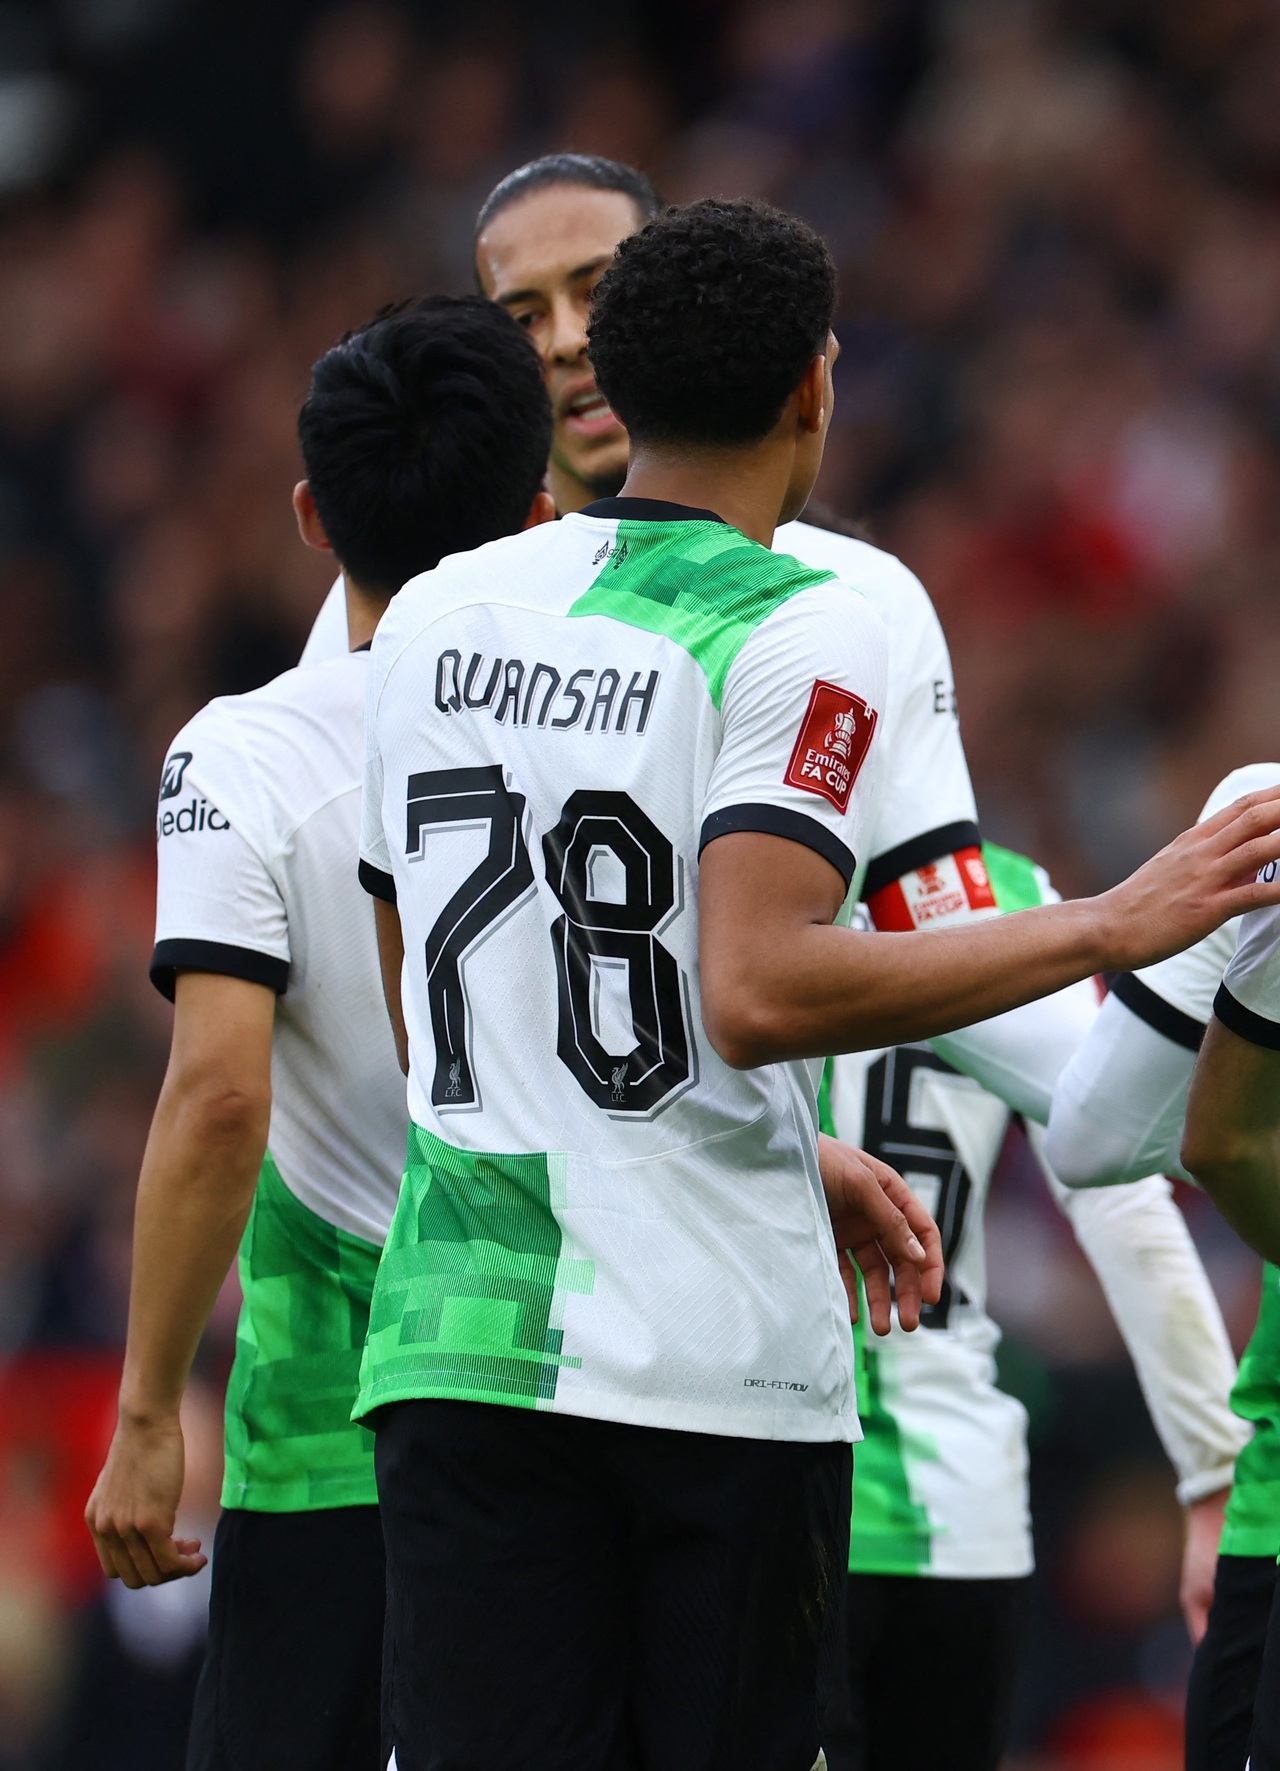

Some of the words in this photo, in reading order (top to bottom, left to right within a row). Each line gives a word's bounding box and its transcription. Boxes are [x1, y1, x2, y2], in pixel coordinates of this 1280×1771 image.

[434, 648, 661, 735] QUANSAH
[801, 762, 822, 781] FA
[825, 771, 847, 794] CUP
[805, 748, 851, 782] Emirates
[159, 799, 231, 837] edia
[404, 763, 695, 1118] 78
